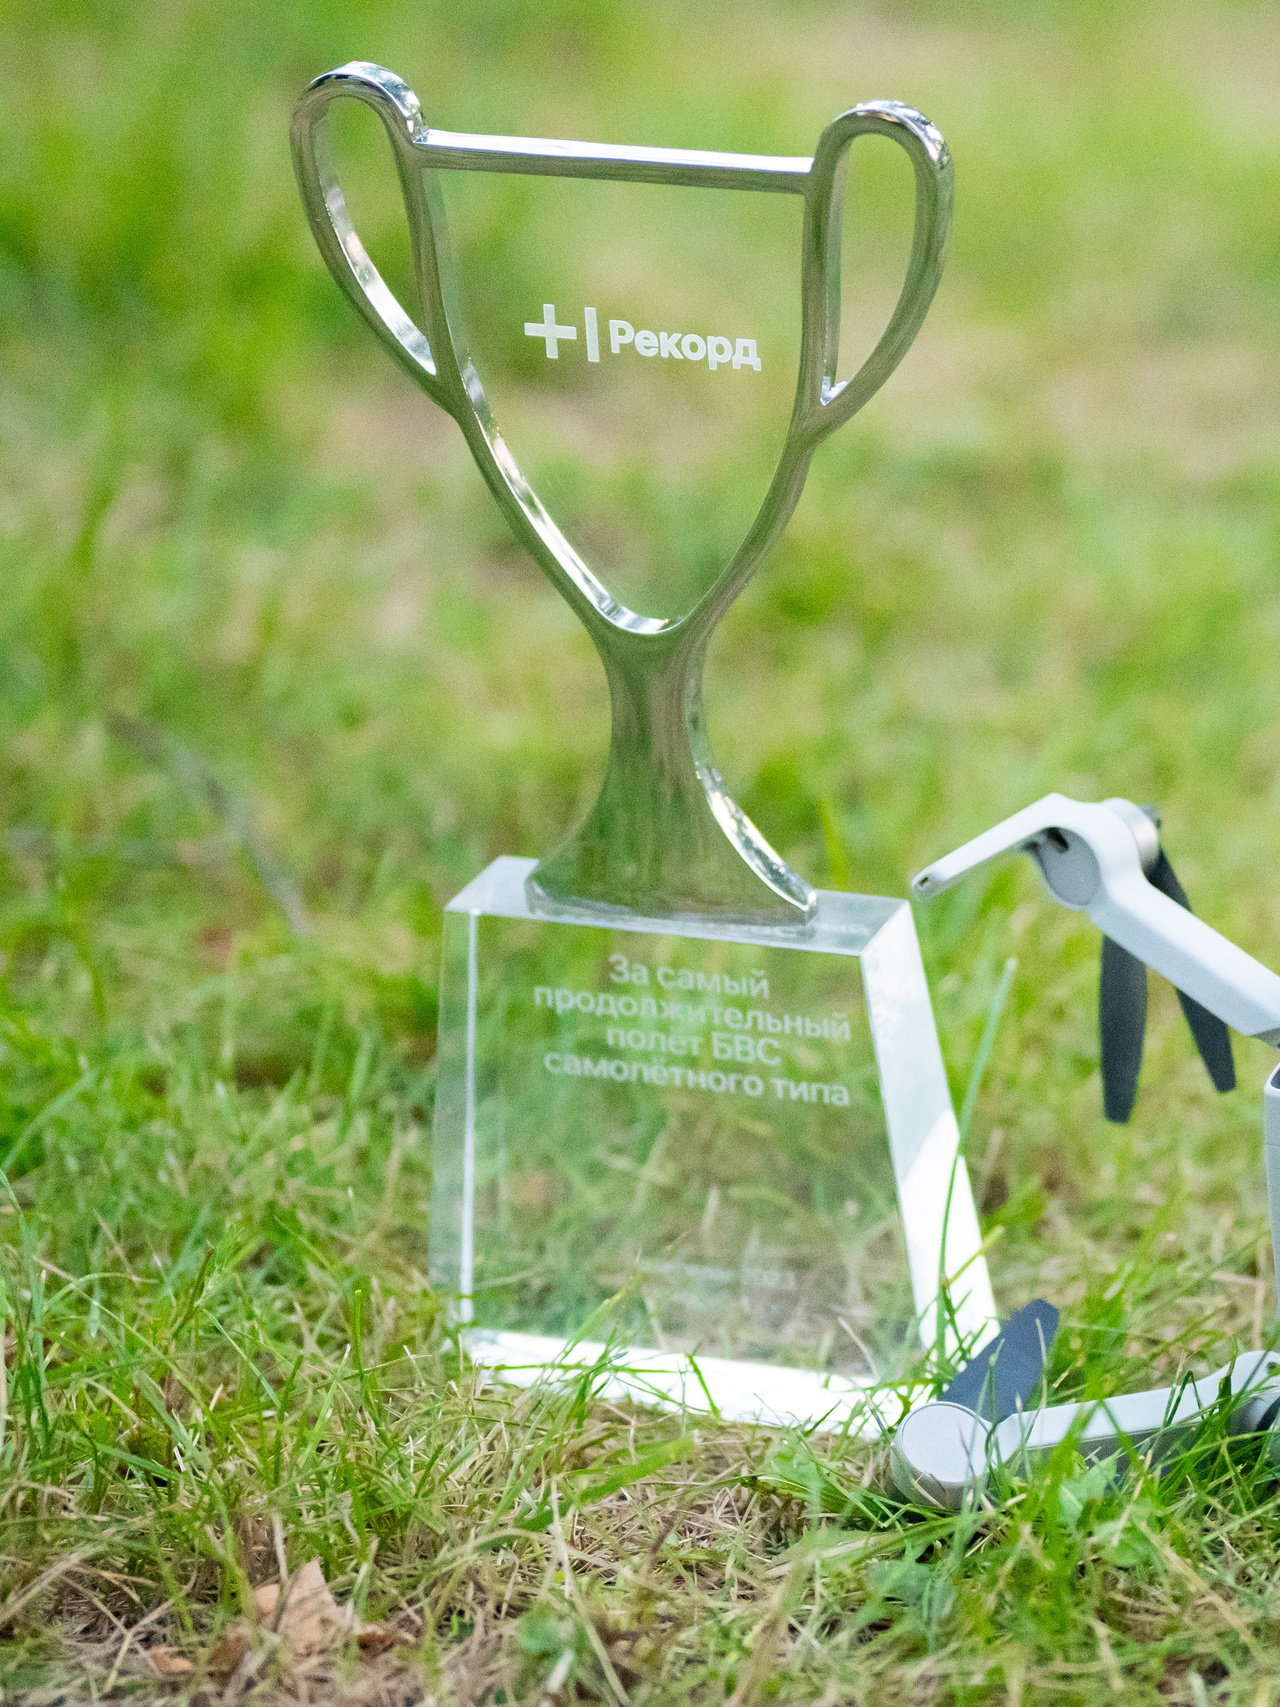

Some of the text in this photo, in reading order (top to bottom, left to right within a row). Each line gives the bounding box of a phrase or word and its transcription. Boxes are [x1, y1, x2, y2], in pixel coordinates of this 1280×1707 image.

[608, 319, 762, 372] Рекорд
[608, 954, 769, 999] За самый
[533, 984, 851, 1041] продолжительный
[711, 1032, 782, 1066] БВС
[544, 1052, 850, 1107] самолётного типа
